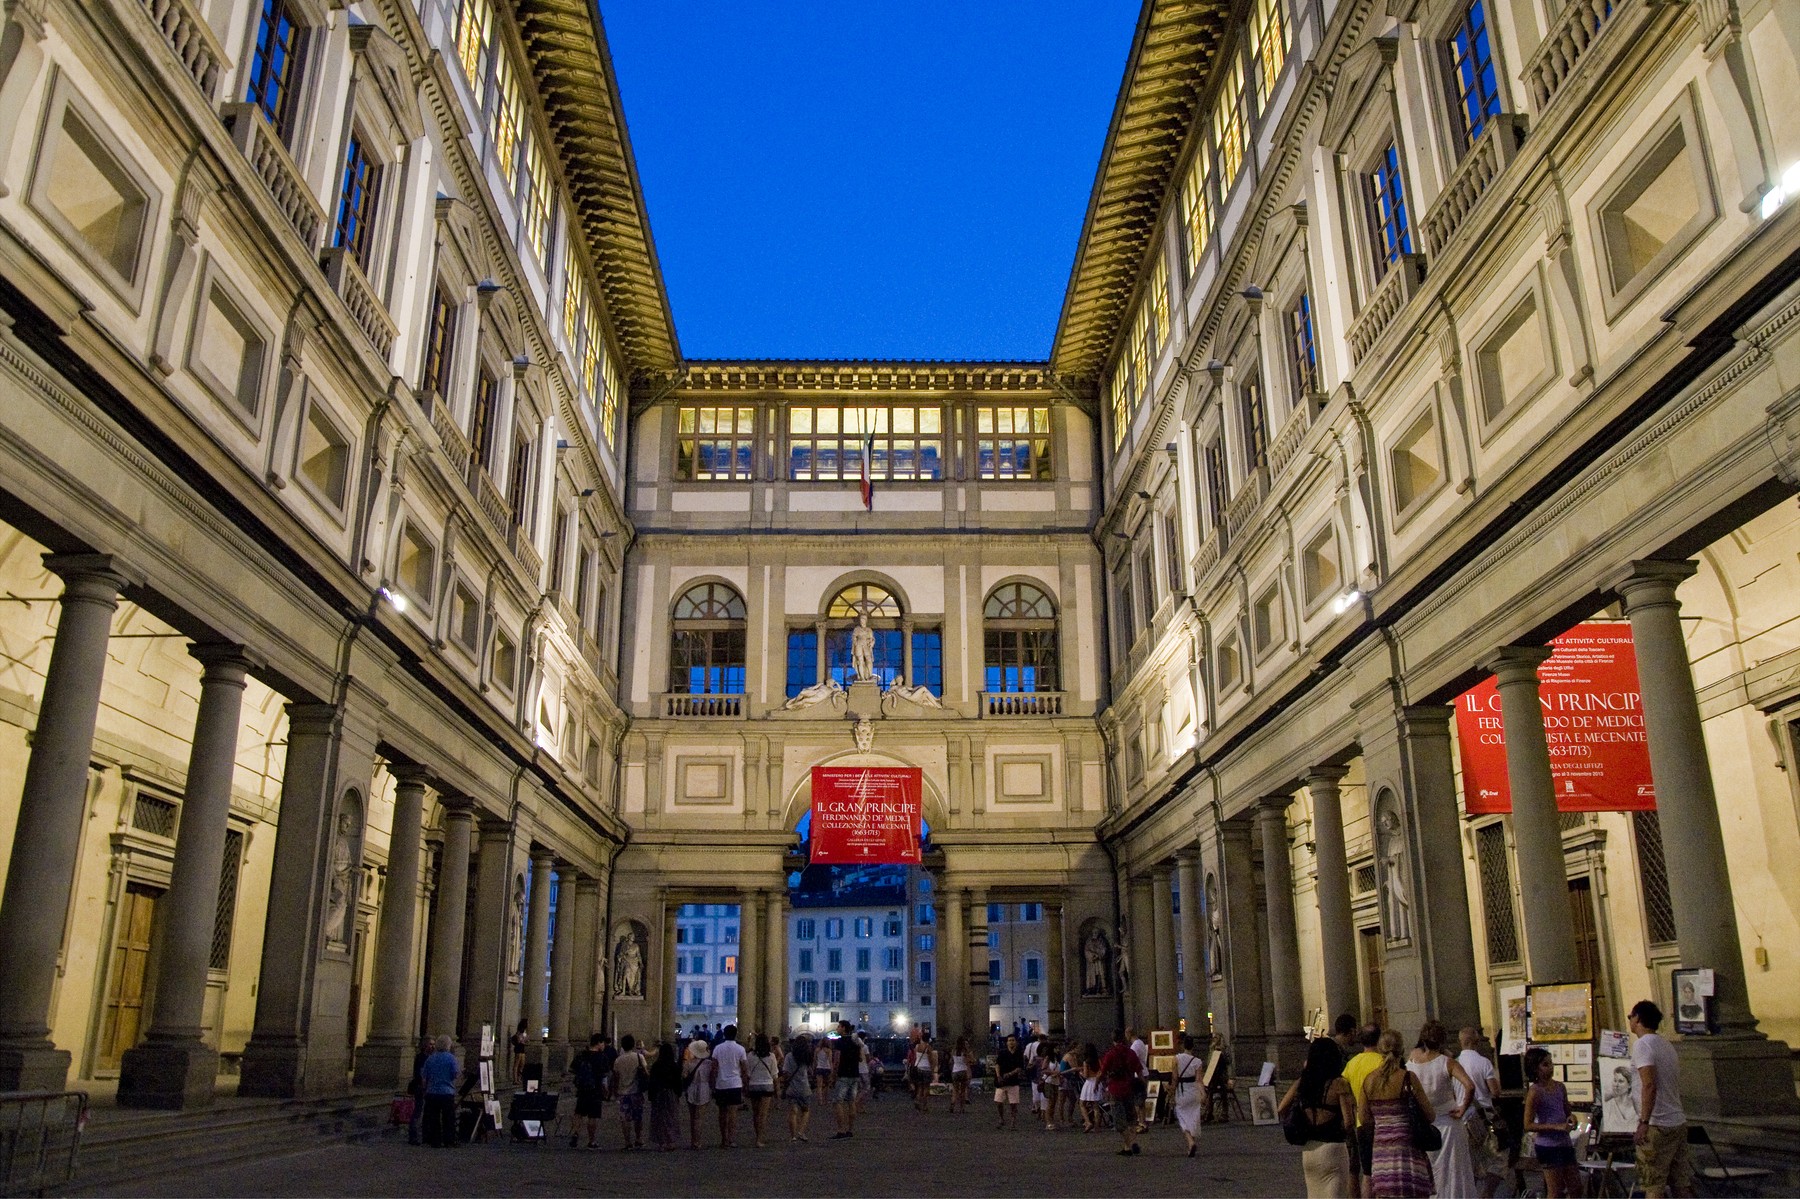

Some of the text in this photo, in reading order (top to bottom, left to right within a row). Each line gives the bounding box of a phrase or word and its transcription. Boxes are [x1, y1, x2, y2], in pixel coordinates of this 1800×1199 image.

[1466, 694, 1484, 712] IL
[1558, 692, 1642, 711] PRINCIP
[1596, 715, 1644, 727] MEDICI
[1574, 732, 1582, 742] E
[1584, 732, 1648, 742] MECENATE
[817, 802, 916, 813] IL GRAN PRINCIPE
